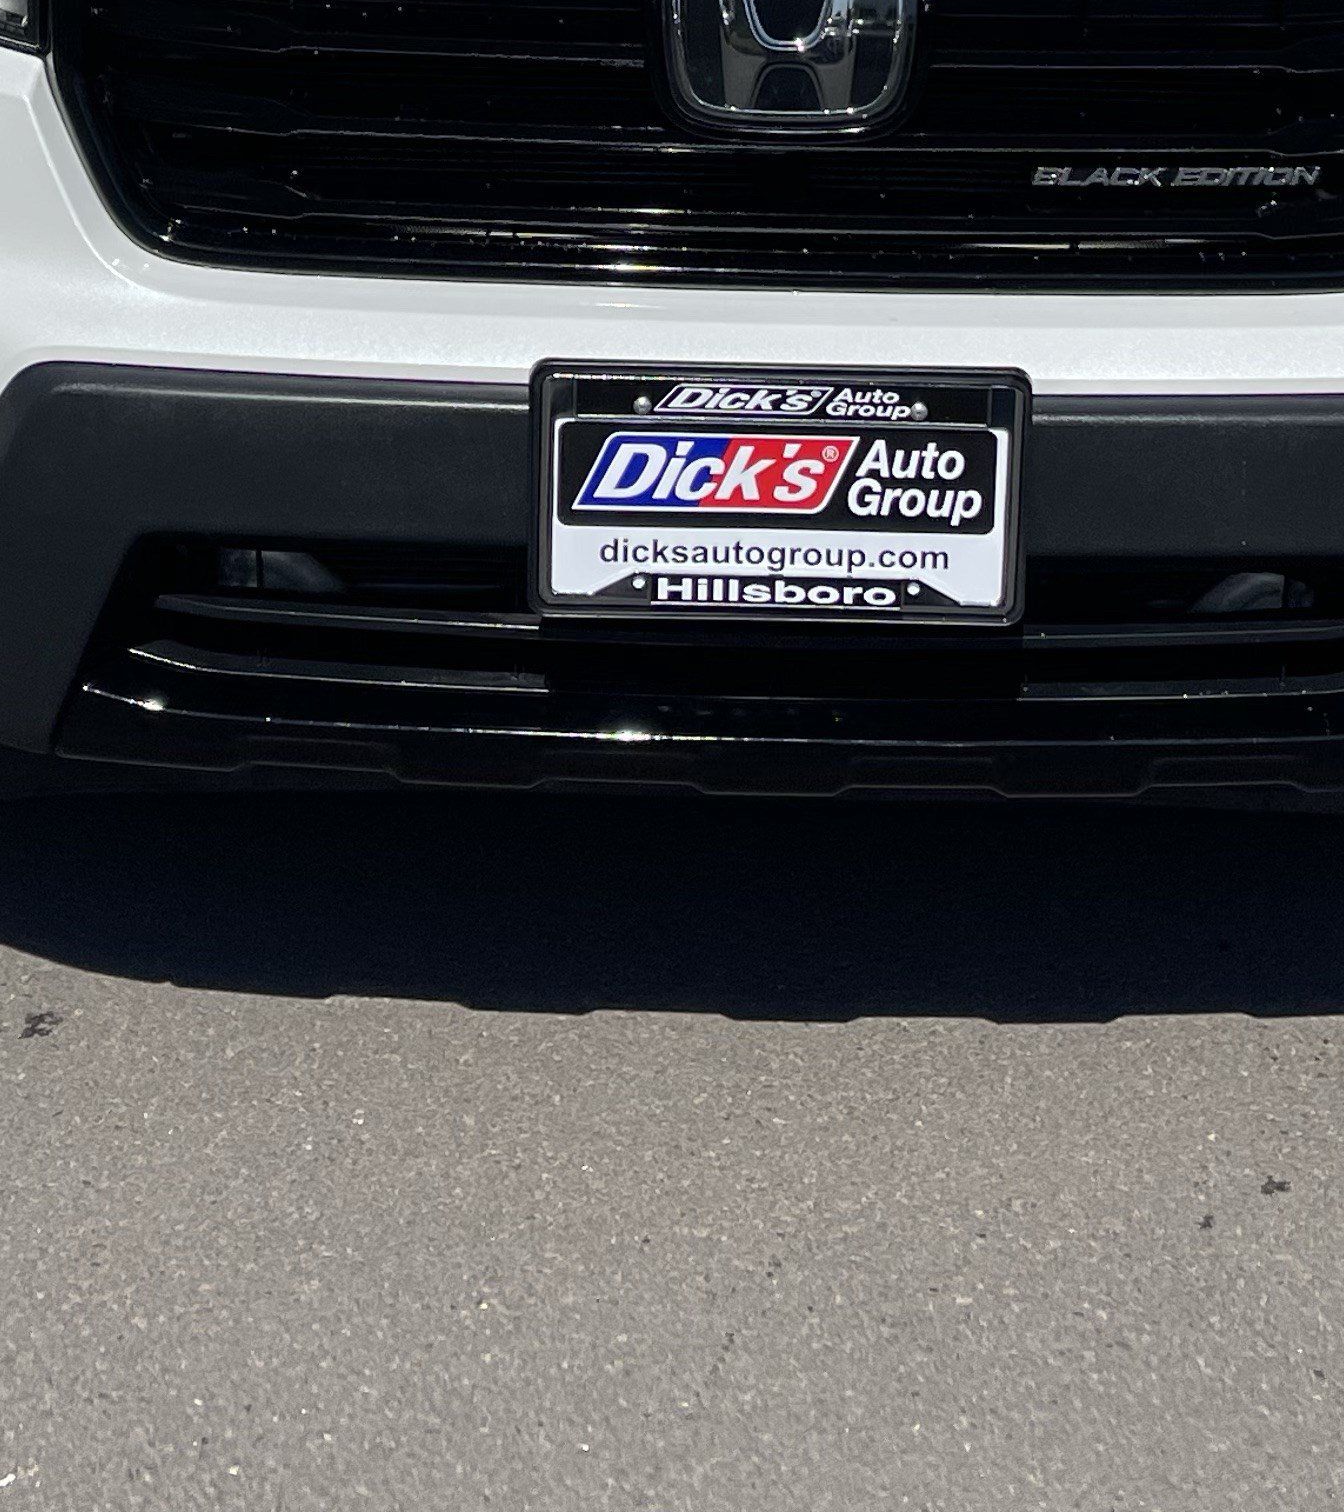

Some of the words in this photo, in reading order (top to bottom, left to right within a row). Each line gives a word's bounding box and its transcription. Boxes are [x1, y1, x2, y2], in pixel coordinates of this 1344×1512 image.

[1032, 166, 1167, 187] BLACK
[1170, 166, 1321, 187] EDITION
[666, 387, 814, 411] Dick's
[833, 387, 901, 405] Auto
[825, 401, 912, 421] Group
[592, 439, 827, 503] Dick's
[855, 439, 966, 480] Auto
[846, 478, 983, 526] Group
[599, 538, 950, 573] dicksautogroup.com
[656, 577, 897, 607] Hillsboro
